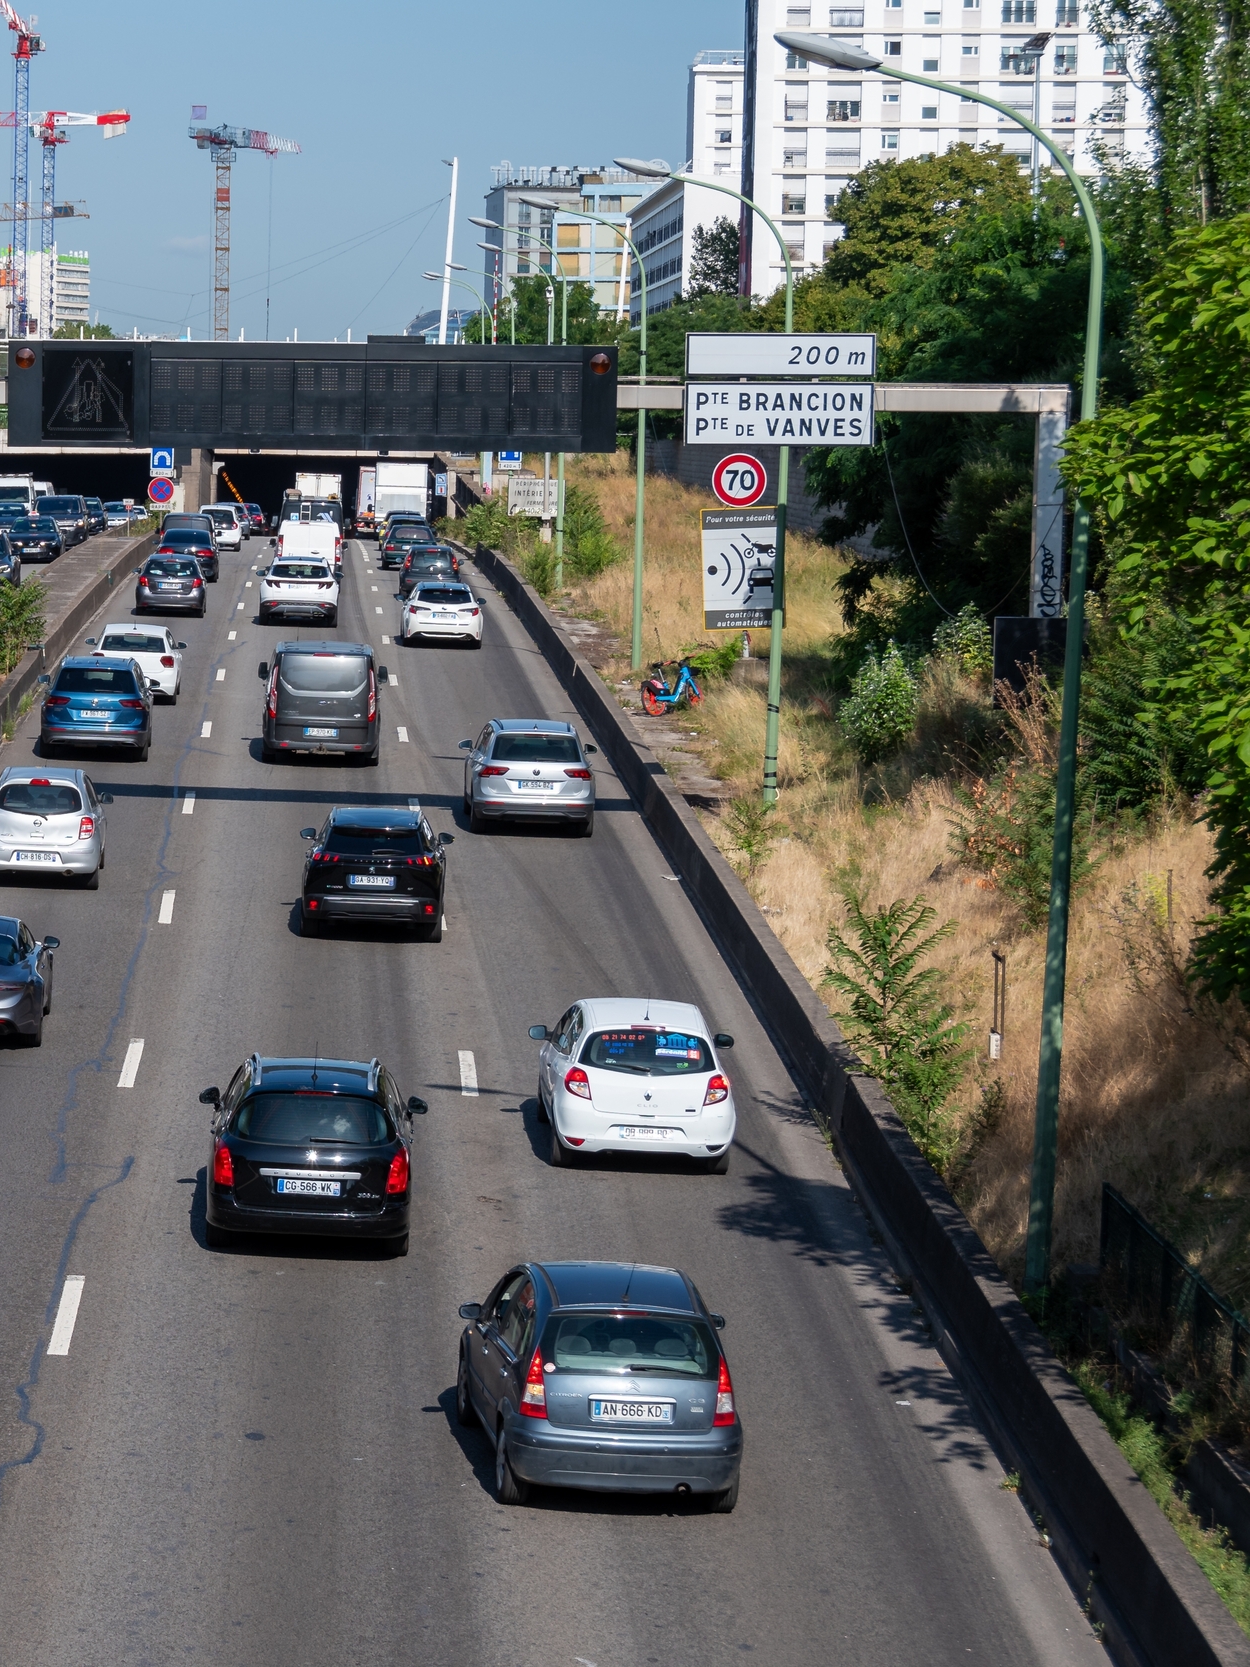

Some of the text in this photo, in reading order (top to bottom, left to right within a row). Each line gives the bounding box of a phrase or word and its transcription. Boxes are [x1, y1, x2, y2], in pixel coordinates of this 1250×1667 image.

[788, 346, 866, 365] 200 m
[739, 392, 863, 412] BRANCION
[736, 424, 754, 436] DE
[766, 418, 862, 437] VANVES
[725, 469, 756, 491] 70
[746, 514, 776, 522] sécurité
